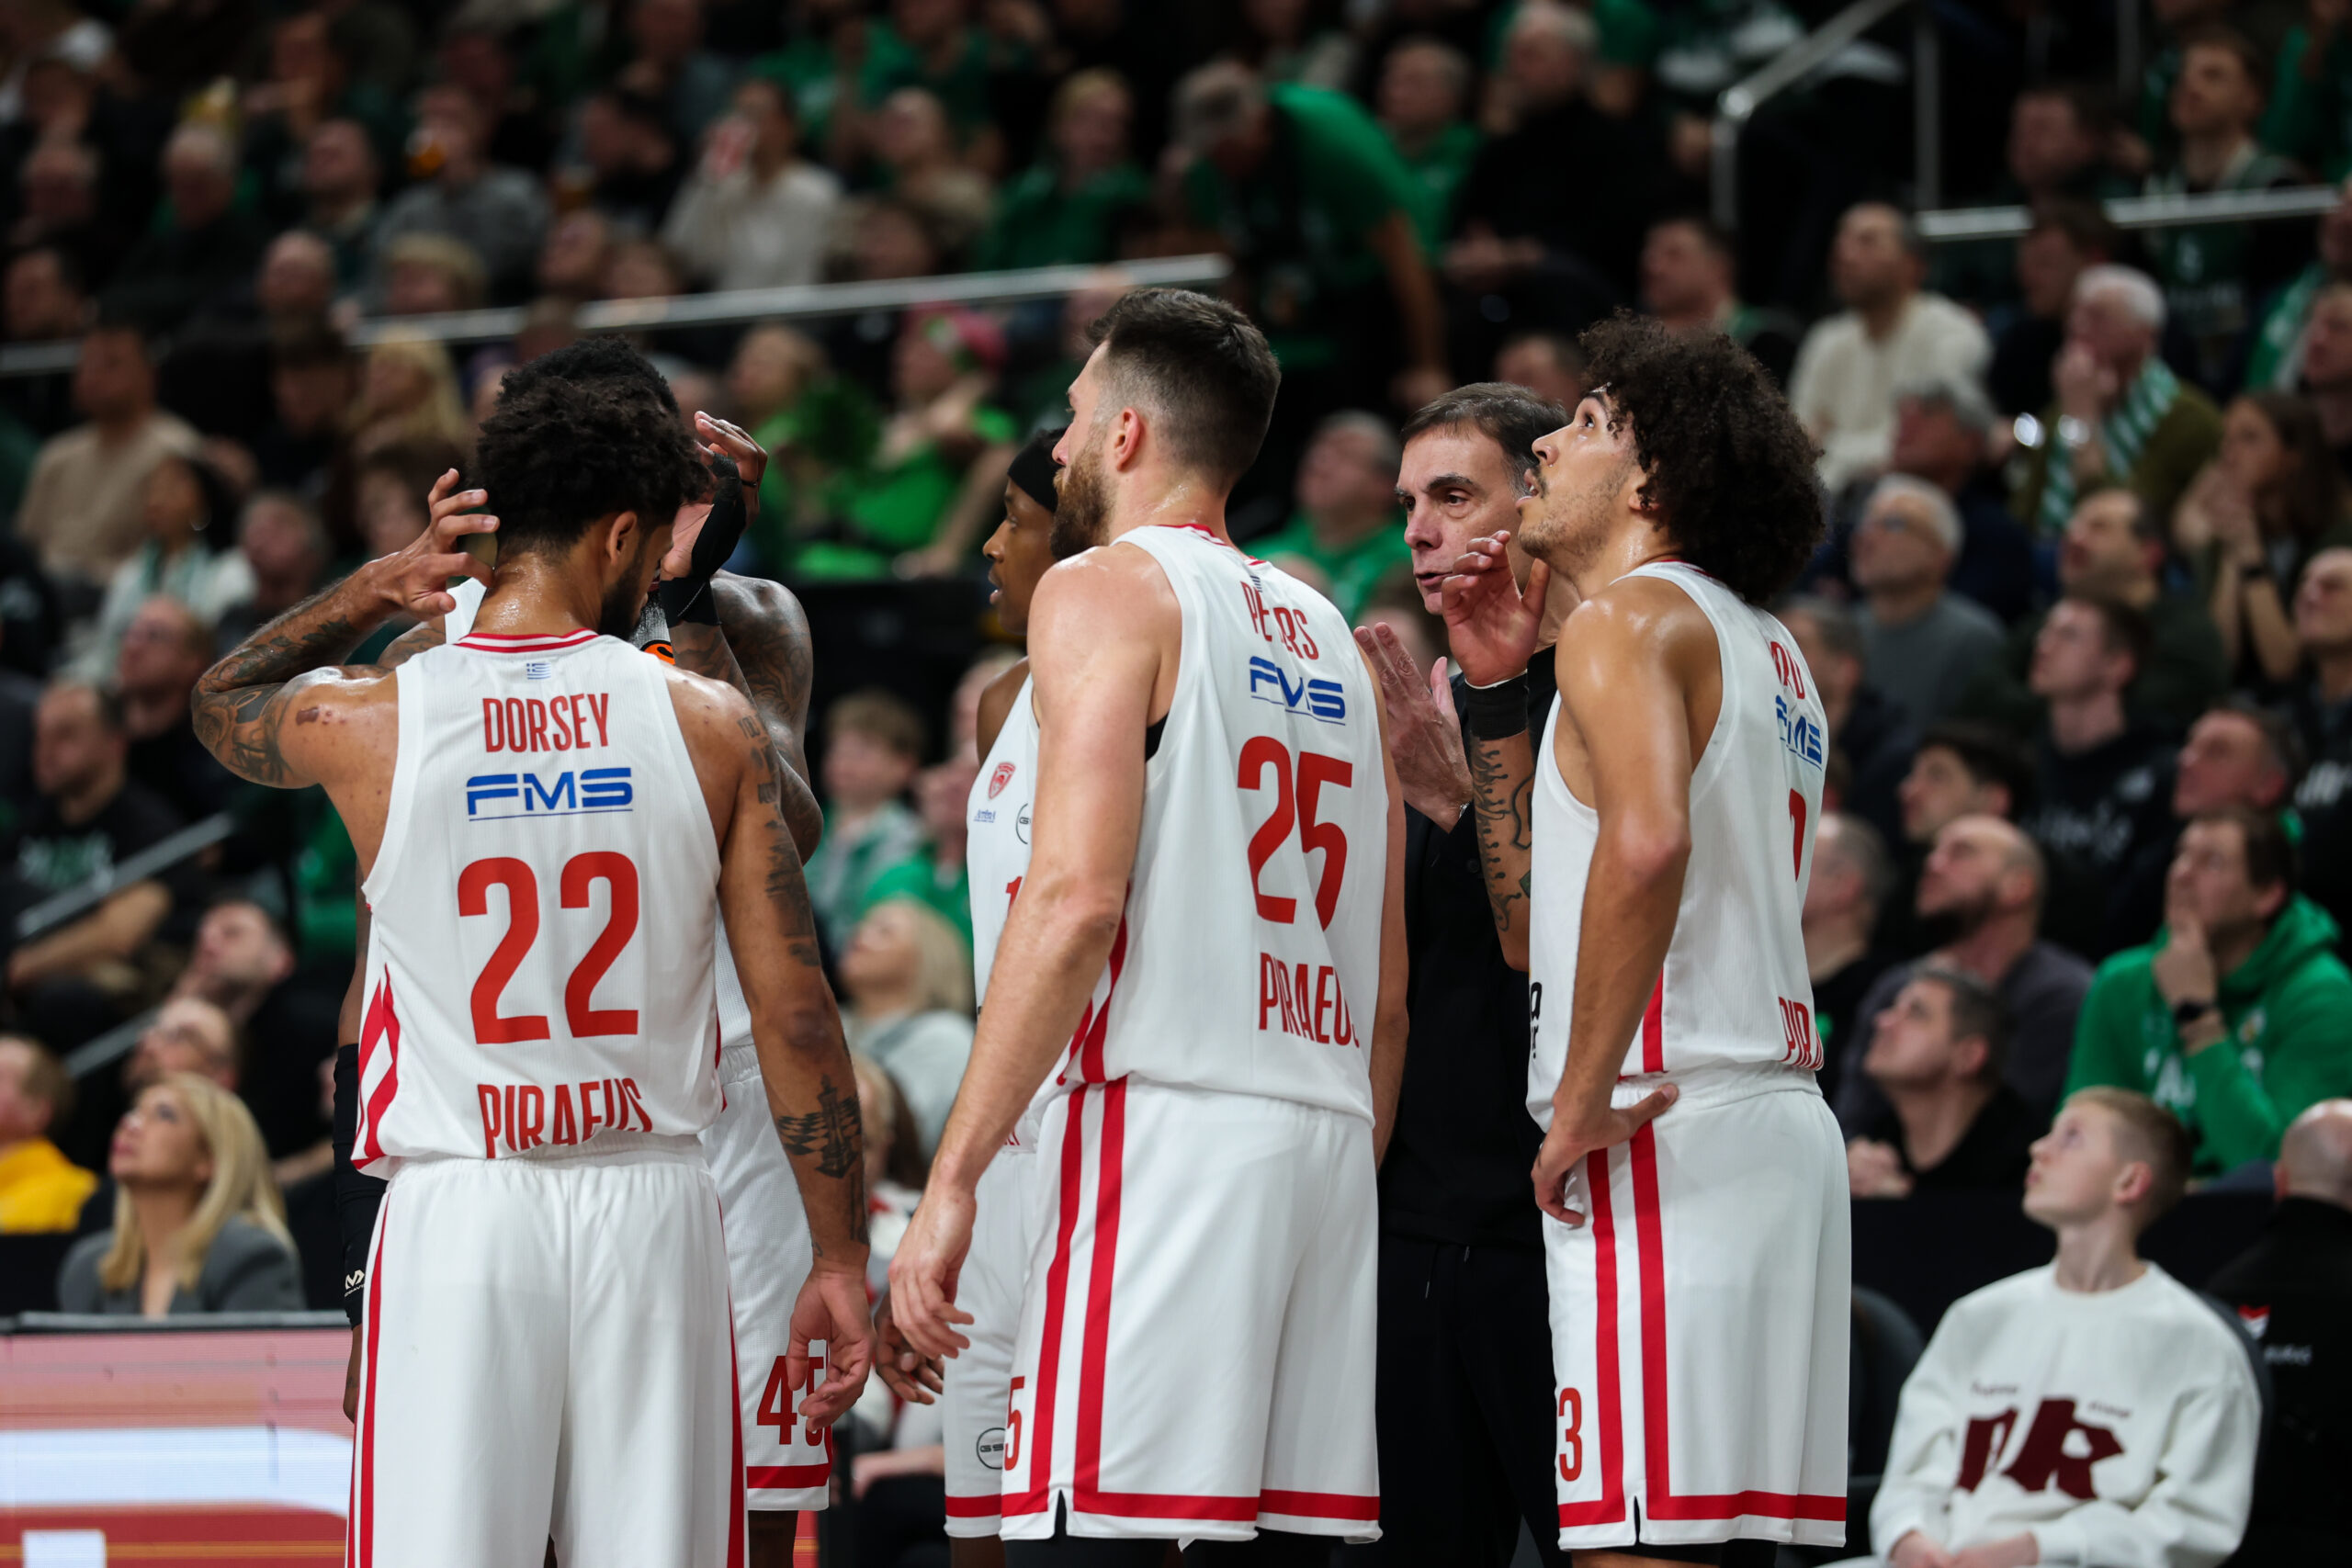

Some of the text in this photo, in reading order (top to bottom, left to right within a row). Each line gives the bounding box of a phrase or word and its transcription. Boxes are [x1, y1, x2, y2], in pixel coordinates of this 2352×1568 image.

[482, 693, 609, 753] DORSEY
[1250, 656, 1346, 719] FMS
[466, 767, 633, 816] FMS
[1237, 735, 1353, 933] 25
[457, 851, 639, 1044] 22
[1558, 1386, 1583, 1483] 3
